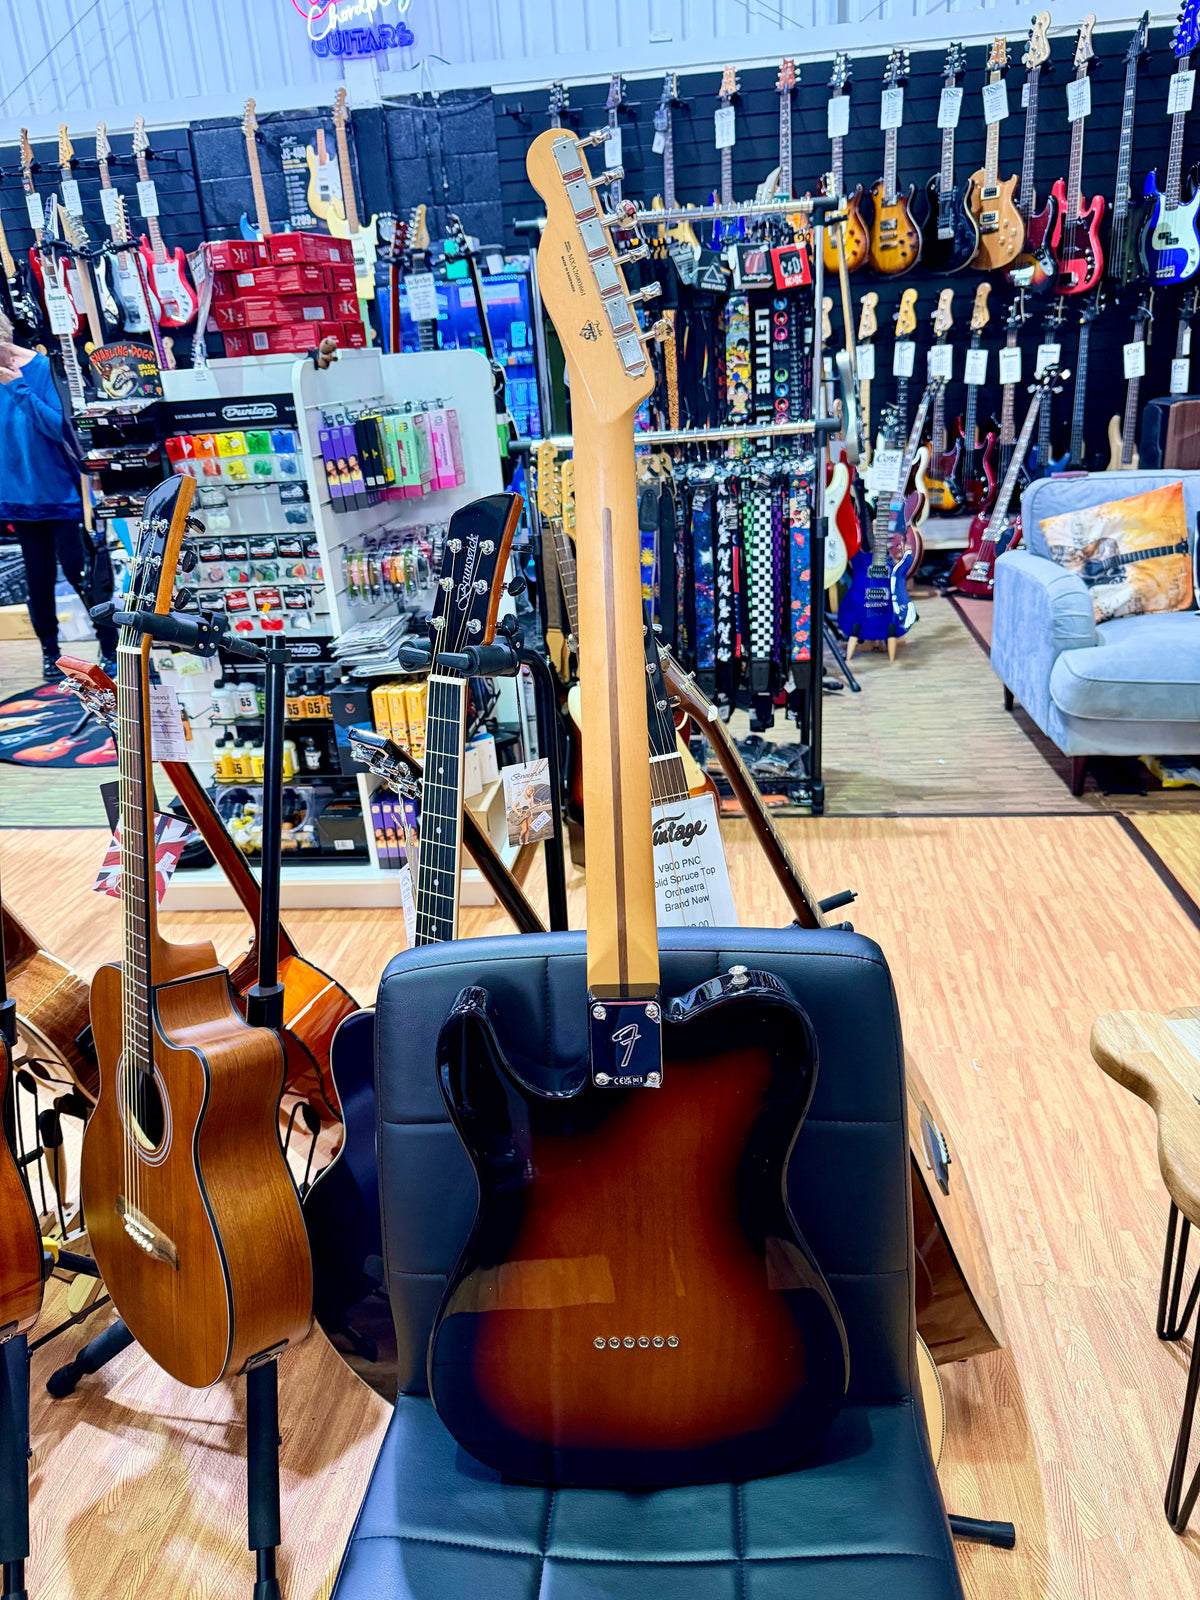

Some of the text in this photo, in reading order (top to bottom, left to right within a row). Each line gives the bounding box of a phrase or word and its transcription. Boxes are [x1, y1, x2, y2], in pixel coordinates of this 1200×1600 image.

[311, 21, 414, 57] GUITARS
[754, 308, 770, 345] LET
[89, 345, 129, 365] SNARLING
[755, 347, 771, 367] IT
[756, 369, 772, 395] BE
[225, 405, 274, 418] Dunlop
[455, 533, 479, 611] Brunswick
[291, 644, 318, 655] nlop
[240, 697, 252, 707] 65
[287, 703, 299, 715] 65
[307, 702, 320, 714] 65
[653, 812, 707, 848] intage
[658, 855, 702, 873] V900 PNC
[655, 866, 716, 889] olid Spruce Top
[665, 883, 706, 899] Orchestra
[665, 893, 711, 912] Brand New
